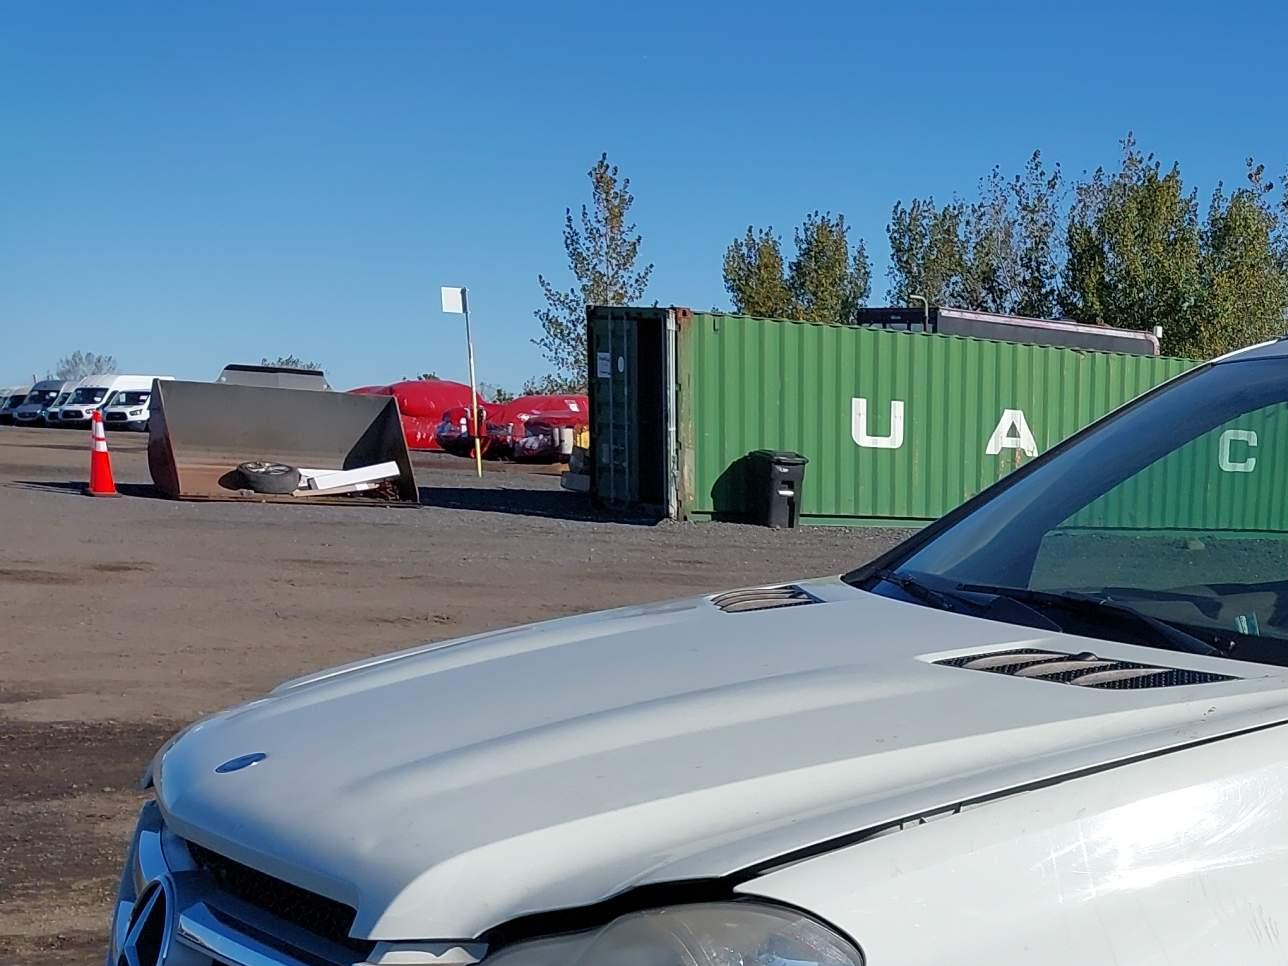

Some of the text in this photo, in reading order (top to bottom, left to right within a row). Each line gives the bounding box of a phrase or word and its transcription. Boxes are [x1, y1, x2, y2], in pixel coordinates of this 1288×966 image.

[852, 397, 1258, 473] U A C
